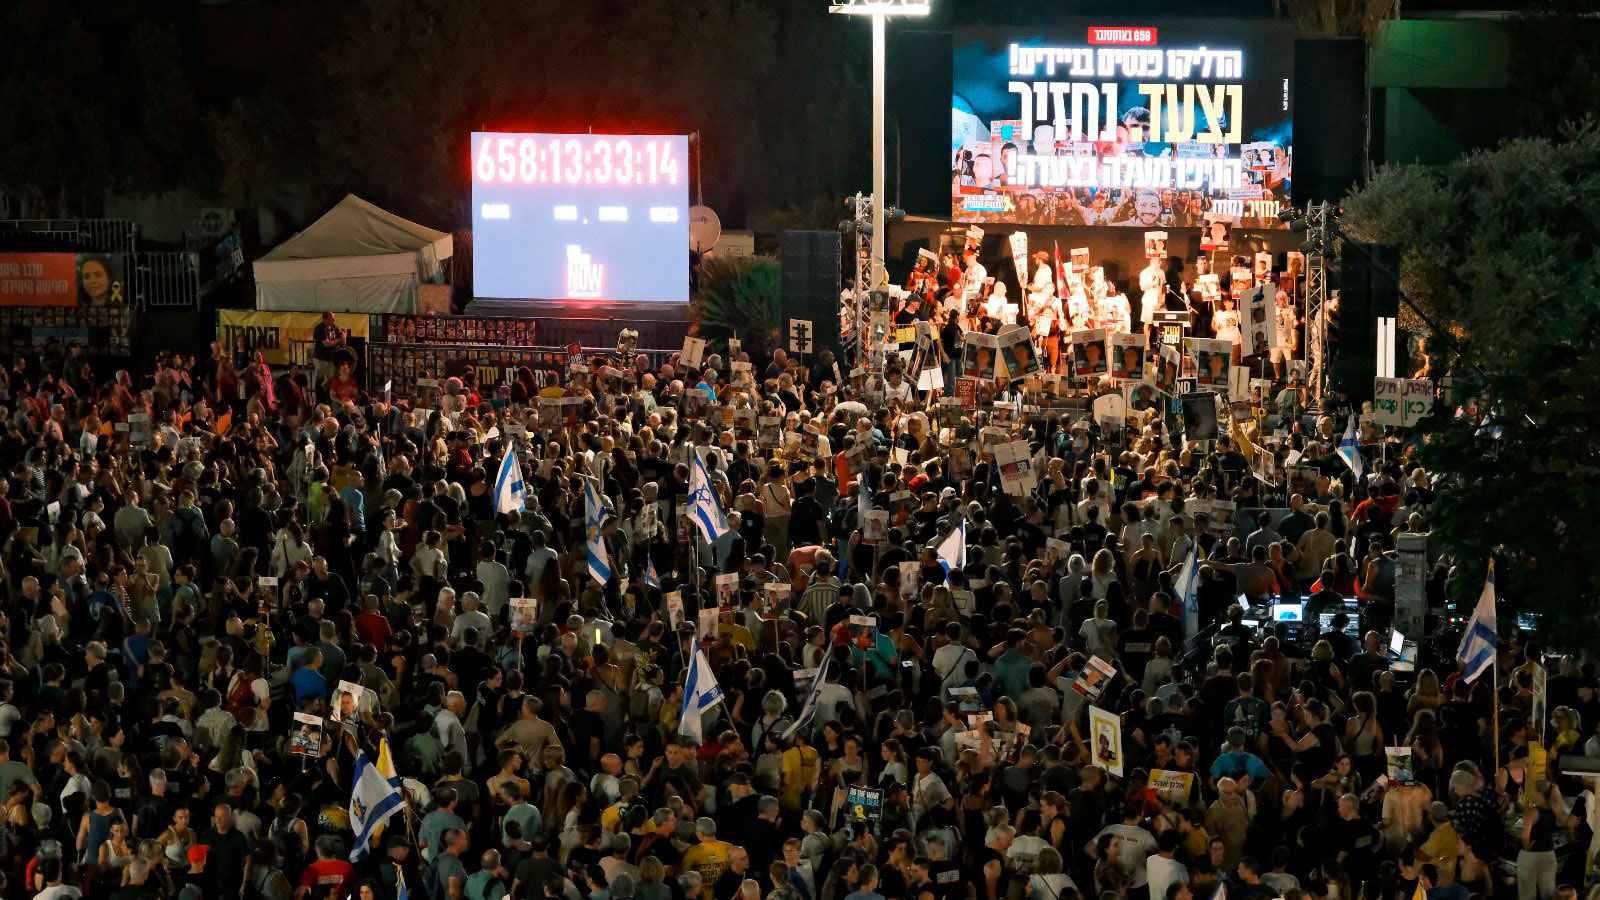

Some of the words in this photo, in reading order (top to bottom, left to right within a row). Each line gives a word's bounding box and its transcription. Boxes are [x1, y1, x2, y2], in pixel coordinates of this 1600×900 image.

[1133, 30, 1151, 41] 658
[1097, 48, 1164, 76] פנסים
[1167, 47, 1241, 79] הדליקו
[1008, 81, 1118, 141] נחזיר
[1131, 84, 1241, 144] נצעד.
[477, 137, 678, 185] 658:13:33:14
